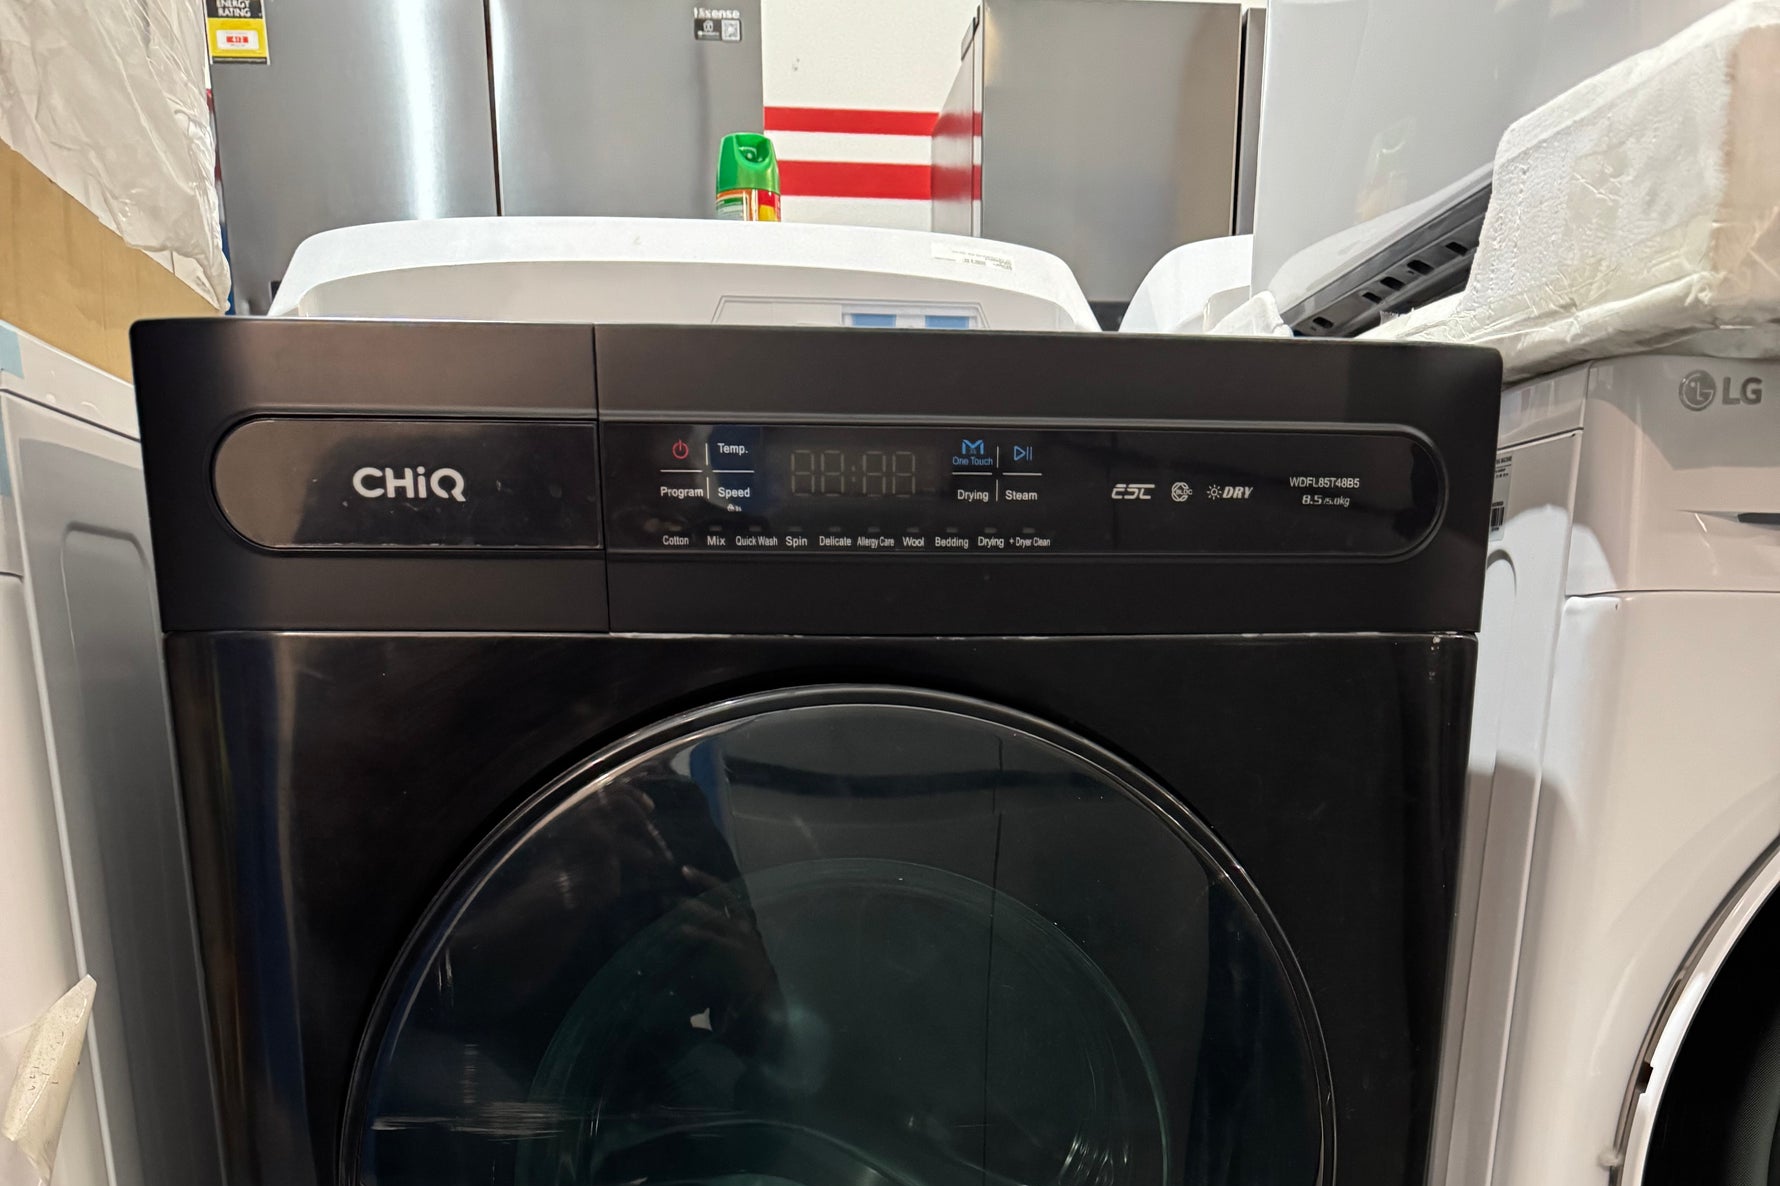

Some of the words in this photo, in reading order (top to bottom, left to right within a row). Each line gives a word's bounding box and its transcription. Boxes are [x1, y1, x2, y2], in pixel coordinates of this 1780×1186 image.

[1721, 376, 1763, 405] LG
[717, 443, 749, 456] Temp.
[952, 456, 969, 465] One
[970, 456, 993, 465] Touch
[352, 466, 466, 502] CHiQ
[1289, 476, 1360, 488] WDFL85T48B5
[660, 486, 704, 499] Program
[718, 486, 750, 499] Speed
[957, 489, 989, 502] Drying
[1005, 489, 1038, 500] Steam
[1222, 486, 1253, 499] DRY
[662, 535, 689, 546] Cotton
[707, 535, 726, 546] Mix
[735, 535, 757, 546] Quick
[757, 535, 778, 546] Wash
[785, 535, 808, 548] Spin
[819, 535, 852, 547] Delicate
[857, 536, 878, 548] Allergy
[879, 536, 895, 547] Care
[902, 536, 925, 547] Wool
[935, 536, 969, 549] Bedding
[977, 536, 1005, 548] Drying
[1015, 536, 1032, 548] Dryer
[1033, 536, 1051, 547] Clean
